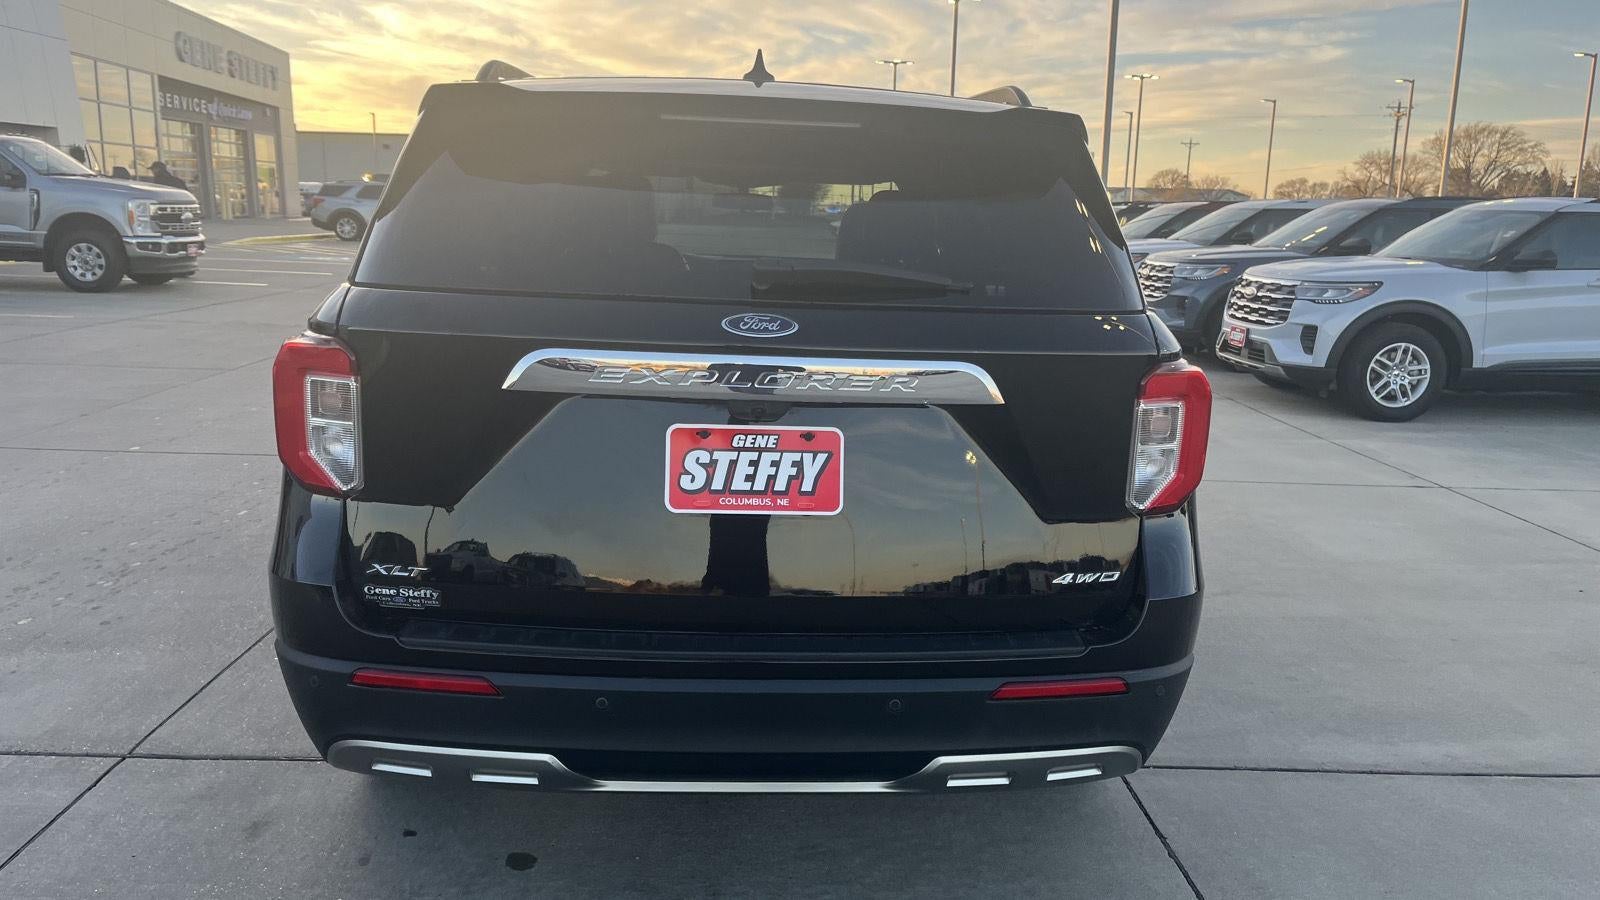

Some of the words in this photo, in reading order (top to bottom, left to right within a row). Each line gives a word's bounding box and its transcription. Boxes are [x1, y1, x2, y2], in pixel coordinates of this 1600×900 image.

[174, 31, 225, 75] GENE
[158, 92, 208, 115] SERVICE
[740, 315, 781, 331] Ford
[588, 367, 919, 392] EXPLORER
[731, 434, 779, 448] GENE
[679, 449, 831, 494] STEFFY
[719, 497, 774, 507] COLUMBUS,
[777, 498, 790, 506] NE
[366, 563, 429, 577] XLT
[1052, 571, 1121, 585] 4WD
[363, 585, 398, 595] Gene
[399, 587, 440, 600] Steffy
